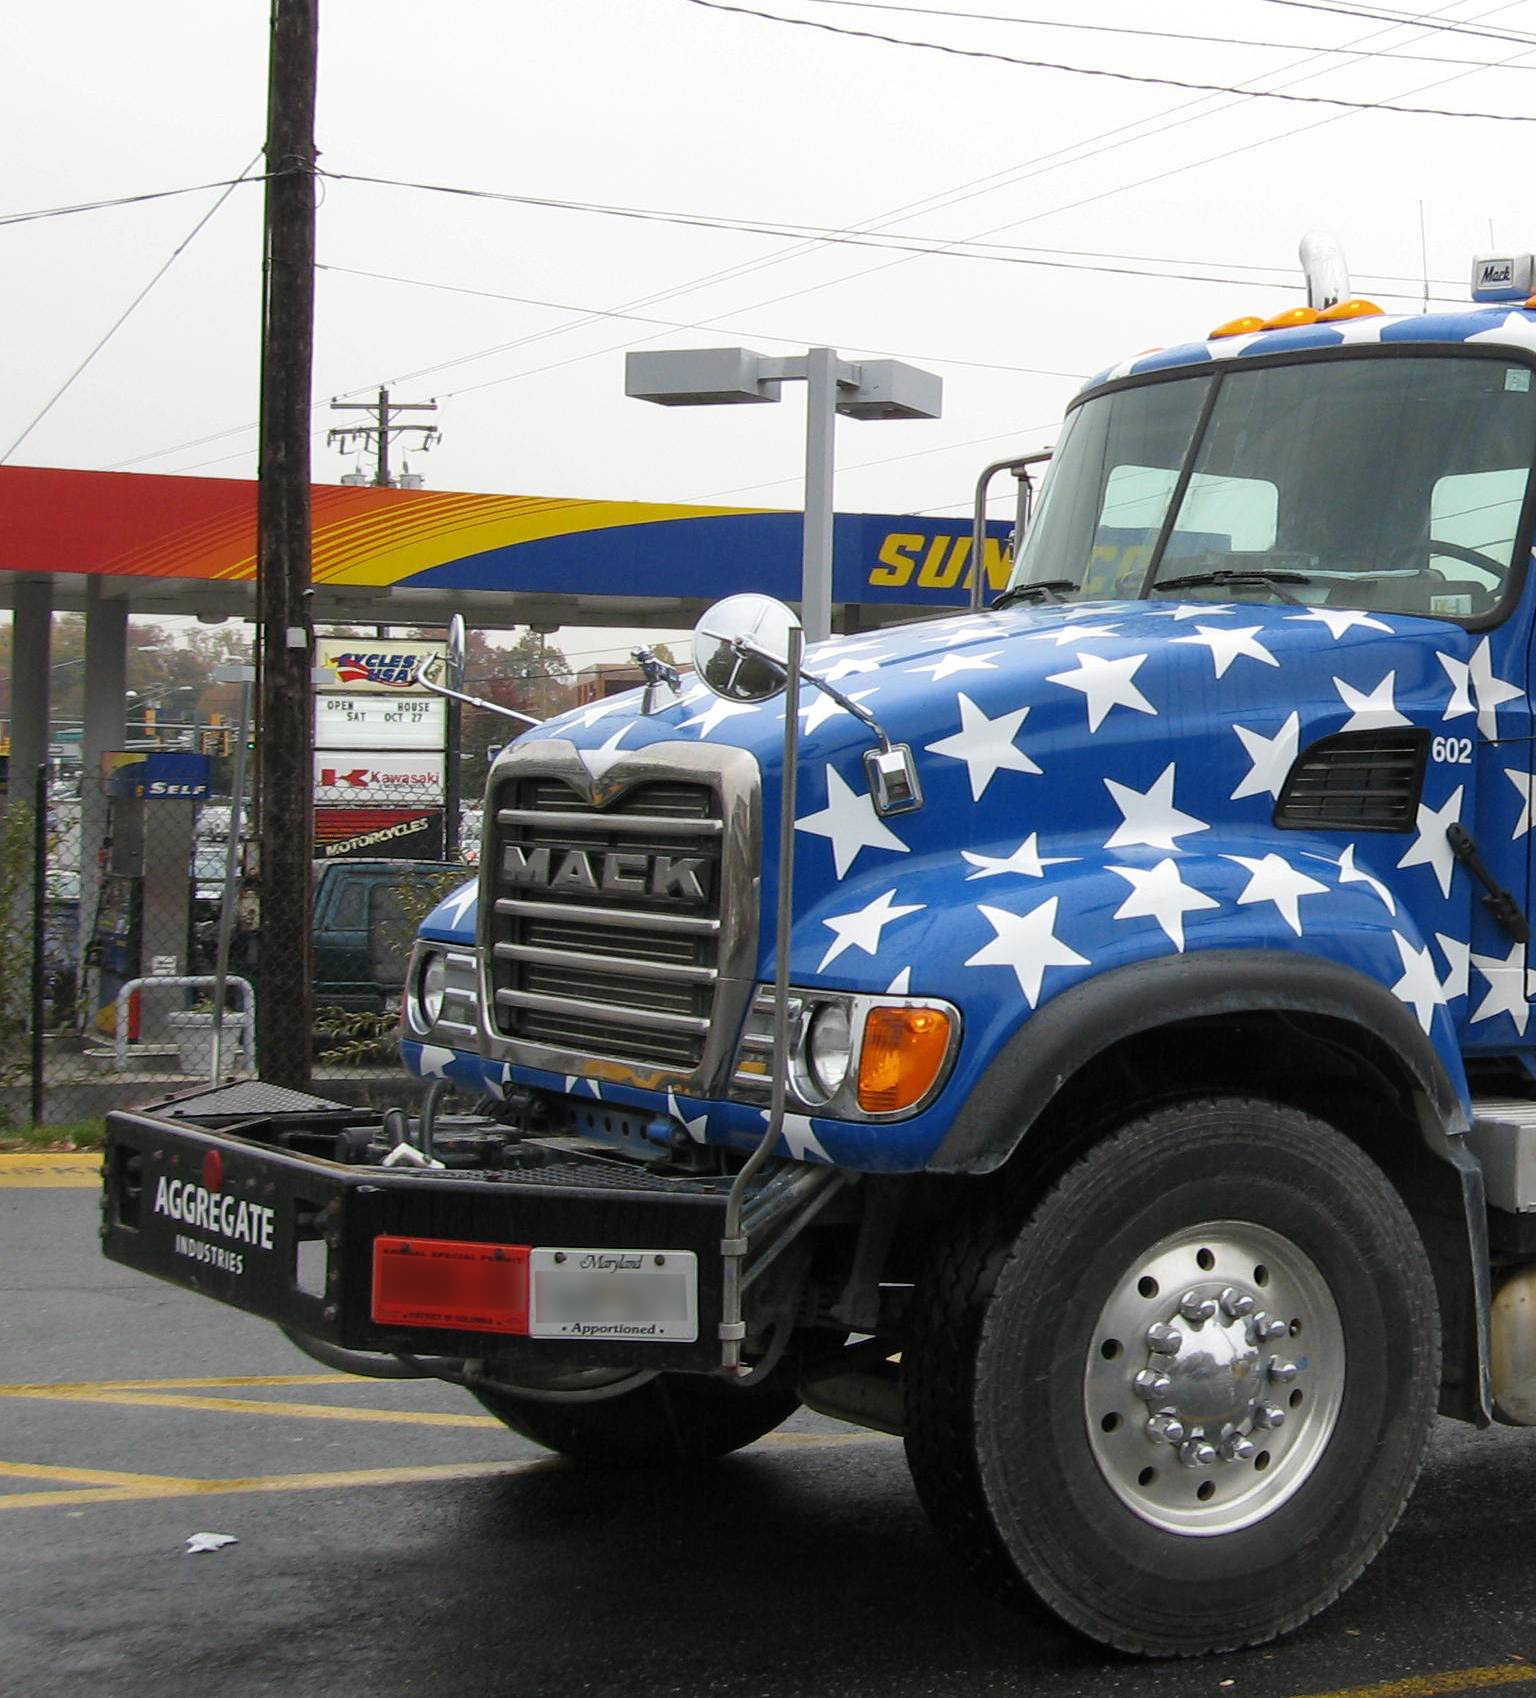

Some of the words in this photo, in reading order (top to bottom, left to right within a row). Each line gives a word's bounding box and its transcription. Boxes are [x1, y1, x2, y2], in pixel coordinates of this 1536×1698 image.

[1480, 266, 1511, 284] Mack
[338, 653, 417, 669] CYCLES
[367, 669, 408, 682] USA
[327, 701, 354, 711] OPEN
[397, 703, 430, 713] HOUSE
[346, 712, 367, 722] SAT
[384, 713, 403, 723] OCT
[411, 714, 423, 723] 27
[1431, 736, 1473, 764] 602
[371, 771, 440, 785] Kawasaki
[150, 781, 207, 795] SELF
[326, 818, 429, 857] MOTORCYCLES
[503, 846, 705, 898] MACK
[154, 1175, 275, 1250] AGGREGATE
[175, 1234, 244, 1275] INDUSTRIES
[579, 1254, 642, 1274] Maryland
[570, 1323, 656, 1335] Apportioned
